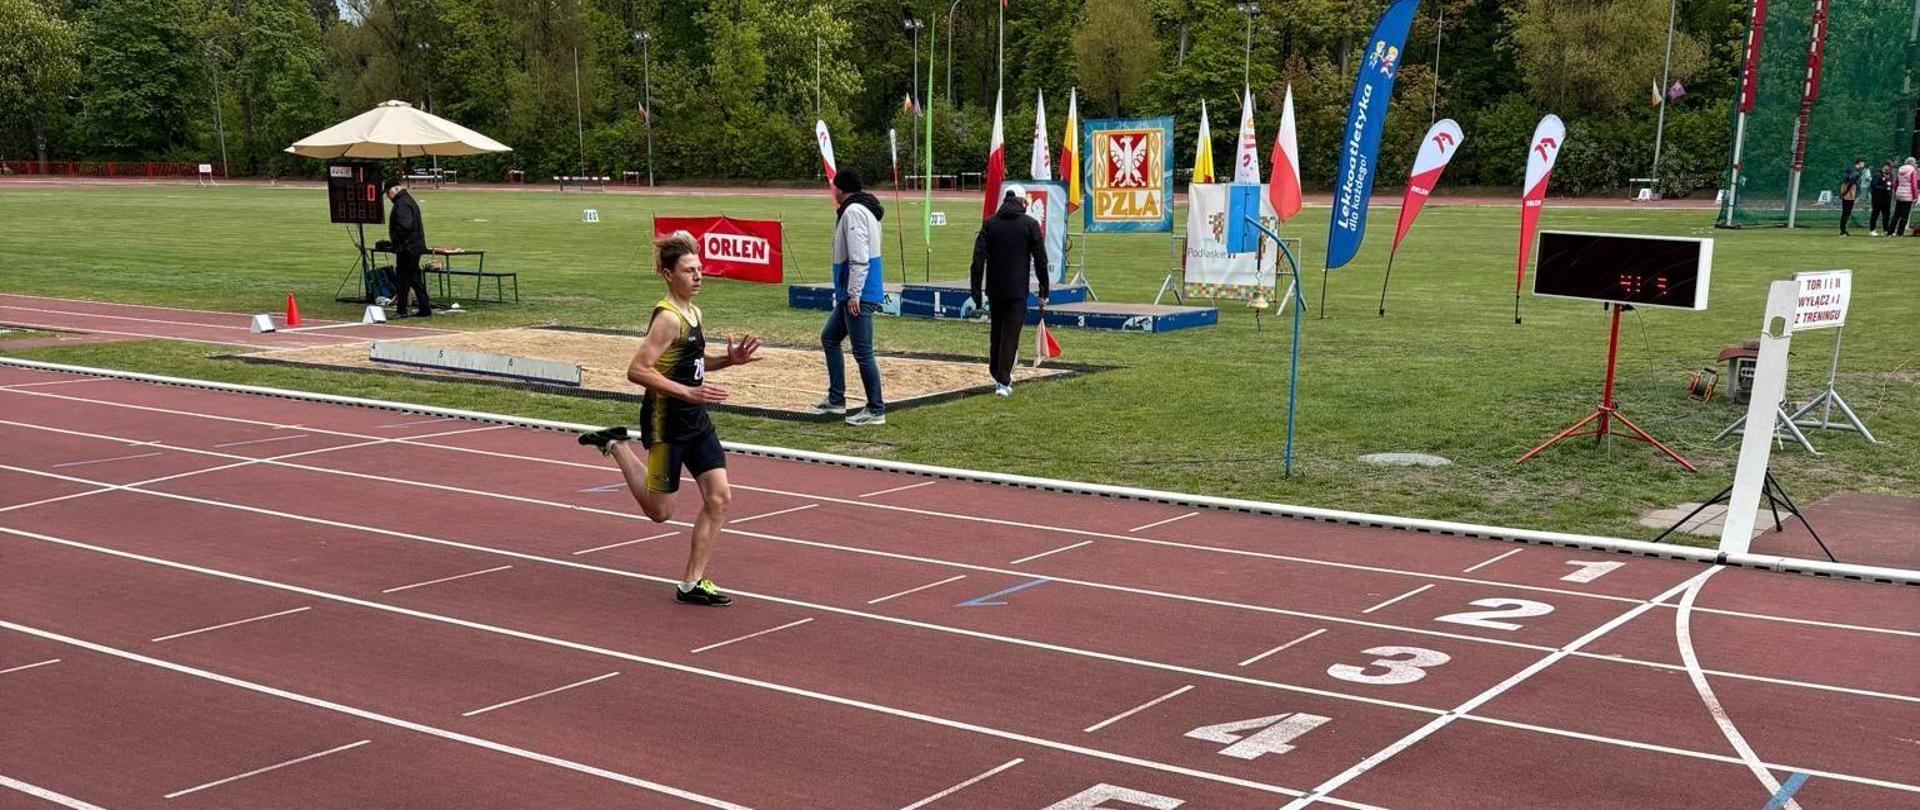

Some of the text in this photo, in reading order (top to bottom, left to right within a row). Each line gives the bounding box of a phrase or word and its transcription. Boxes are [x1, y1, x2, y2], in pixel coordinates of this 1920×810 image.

[1338, 83, 1372, 229] Lekkoatletyka
[1410, 185, 1430, 196] ORLEN
[1097, 191, 1159, 216] PZLA
[1349, 211, 1359, 232] dla
[708, 237, 766, 260] ORLEN
[1187, 247, 1226, 259] Podlaskie
[1806, 279, 1822, 290] TOR
[1078, 315, 1085, 327] 3
[1794, 310, 1842, 324] Z TRENINGU
[438, 350, 444, 358] 5
[508, 357, 514, 367] 6
[1559, 559, 1627, 583] 1
[1433, 598, 1555, 631] 2
[1326, 646, 1452, 685] 3
[1183, 712, 1333, 760] 4
